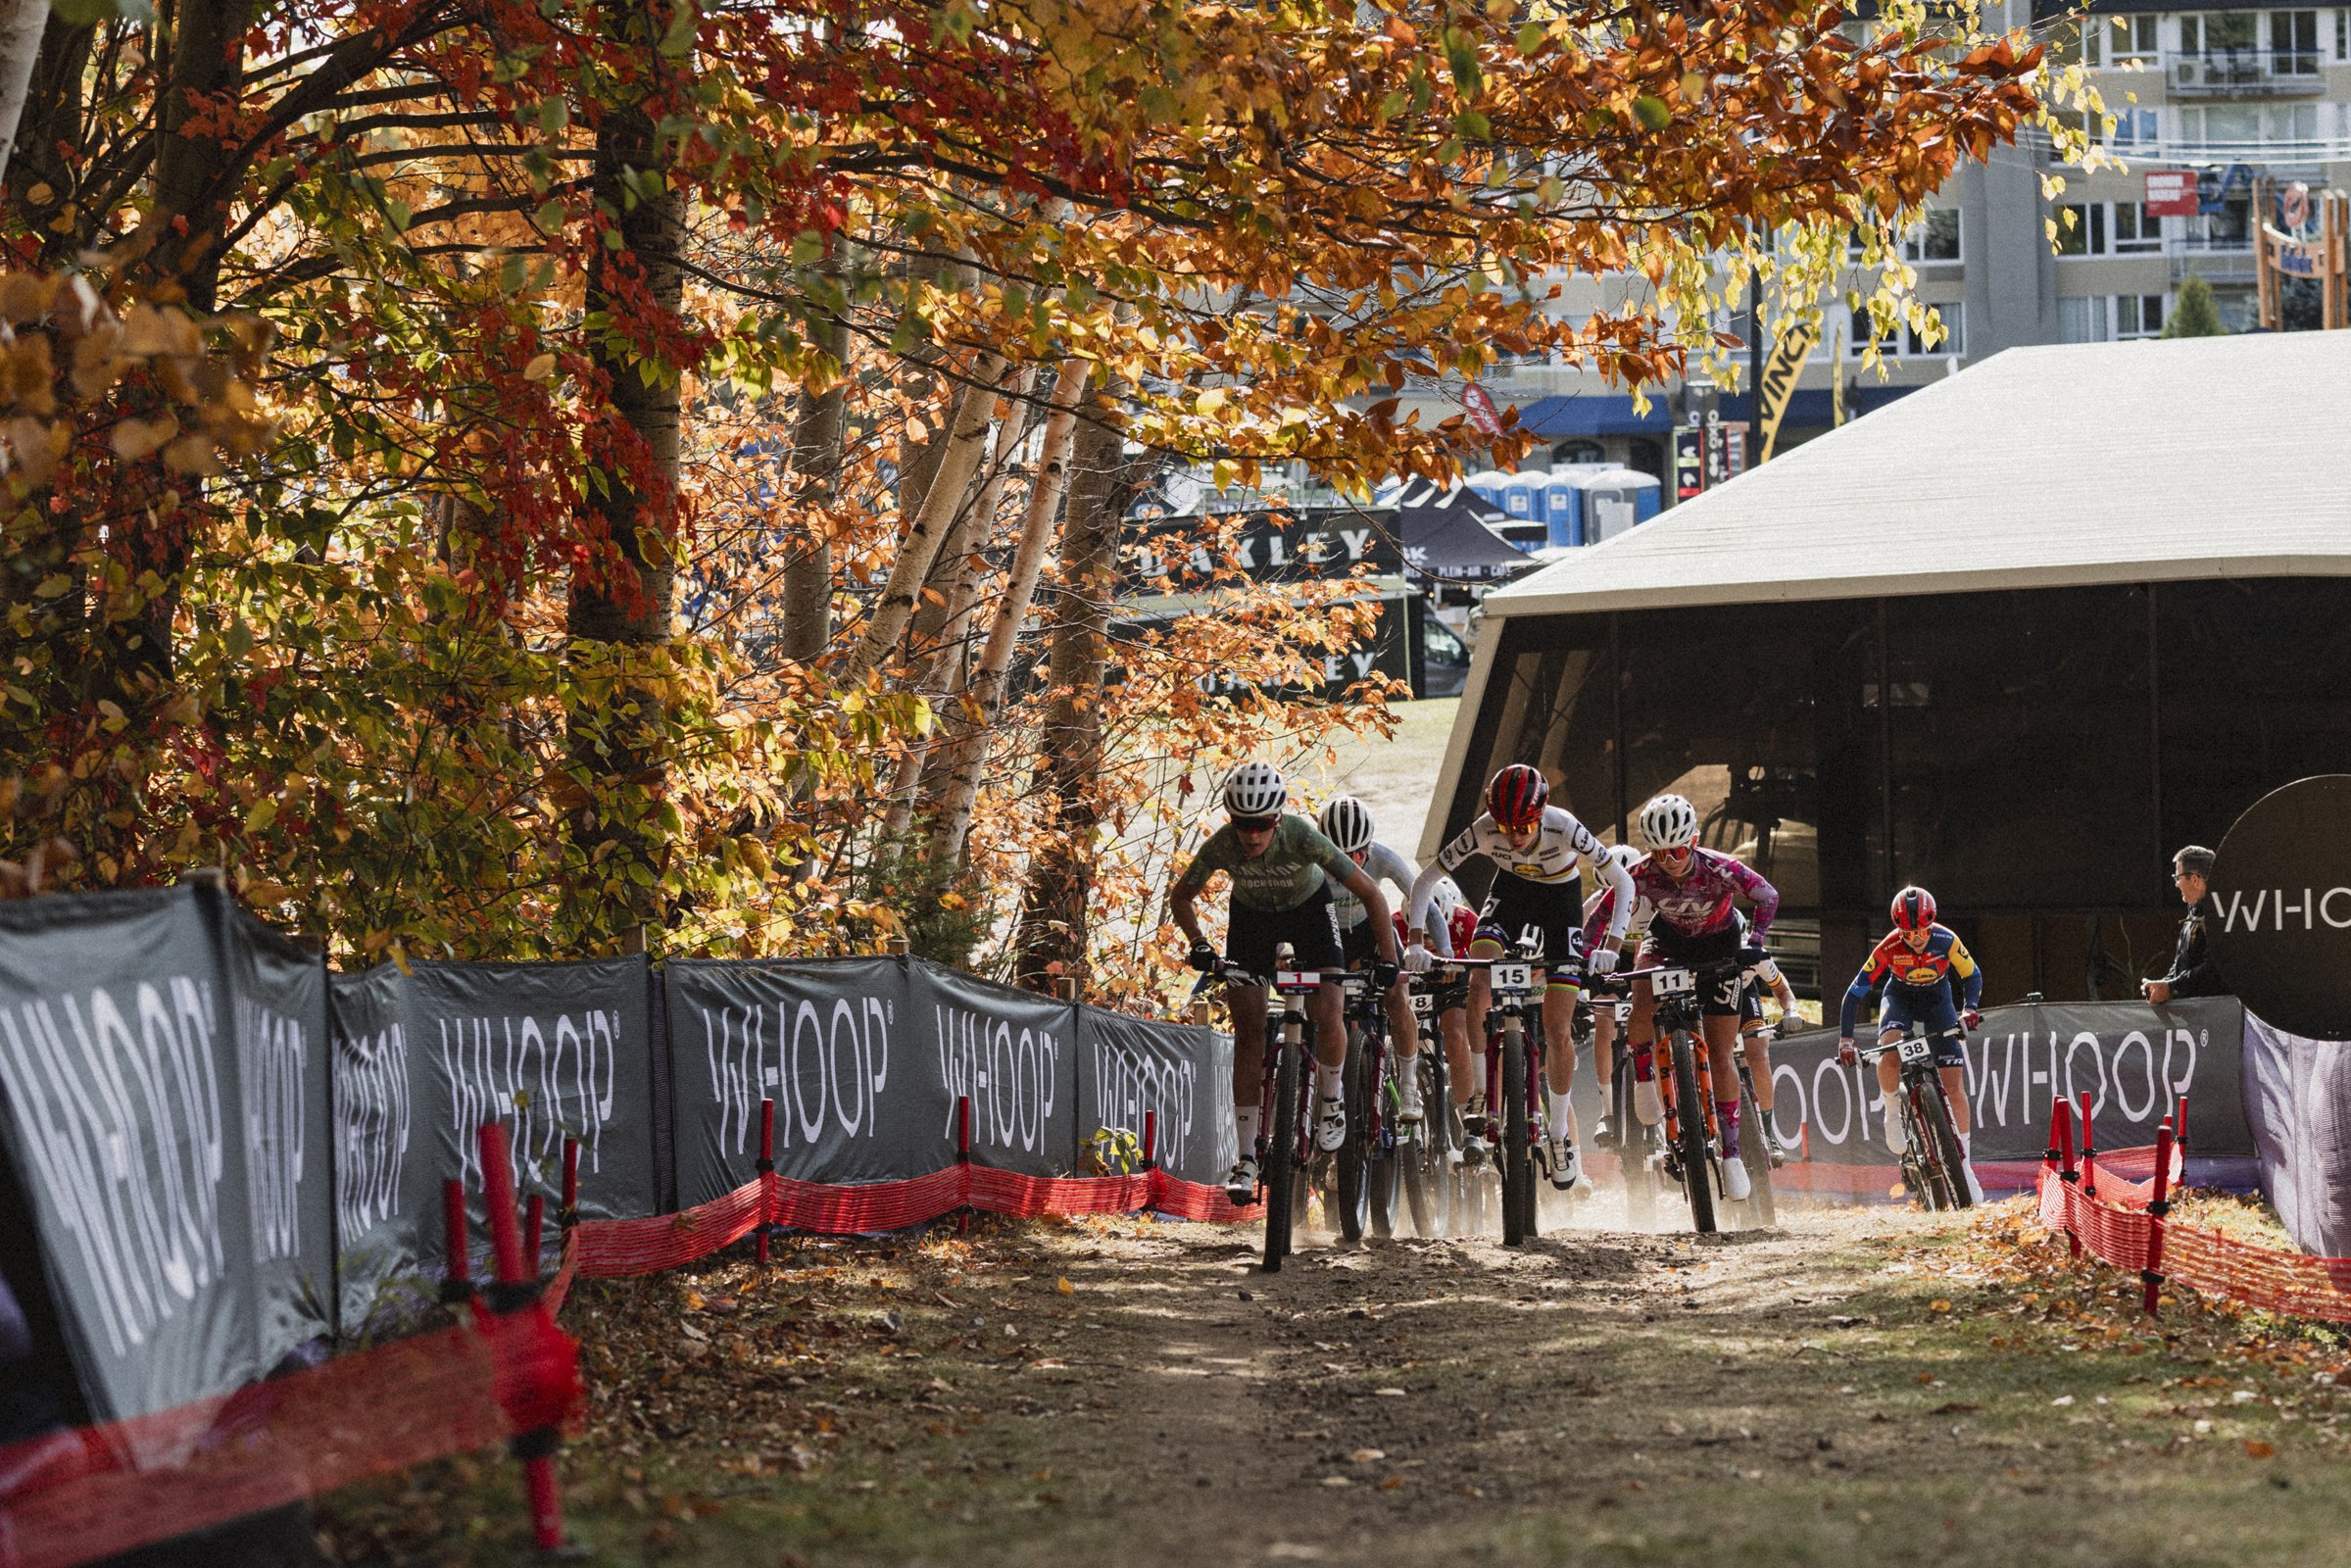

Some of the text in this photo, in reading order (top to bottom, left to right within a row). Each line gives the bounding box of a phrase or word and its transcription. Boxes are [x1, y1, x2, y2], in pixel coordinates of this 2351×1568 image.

[2211, 886, 2351, 933] WHO
[1294, 972, 1302, 984] 1
[1498, 969, 1525, 984] 15
[1659, 973, 1681, 990] 11
[1732, 980, 1741, 1006] FACTORY
[1903, 1042, 1925, 1057] 38
[703, 997, 888, 1159] WHOOP
[936, 1004, 1055, 1156] WHOOP
[1961, 1029, 2196, 1129] WHOOP
